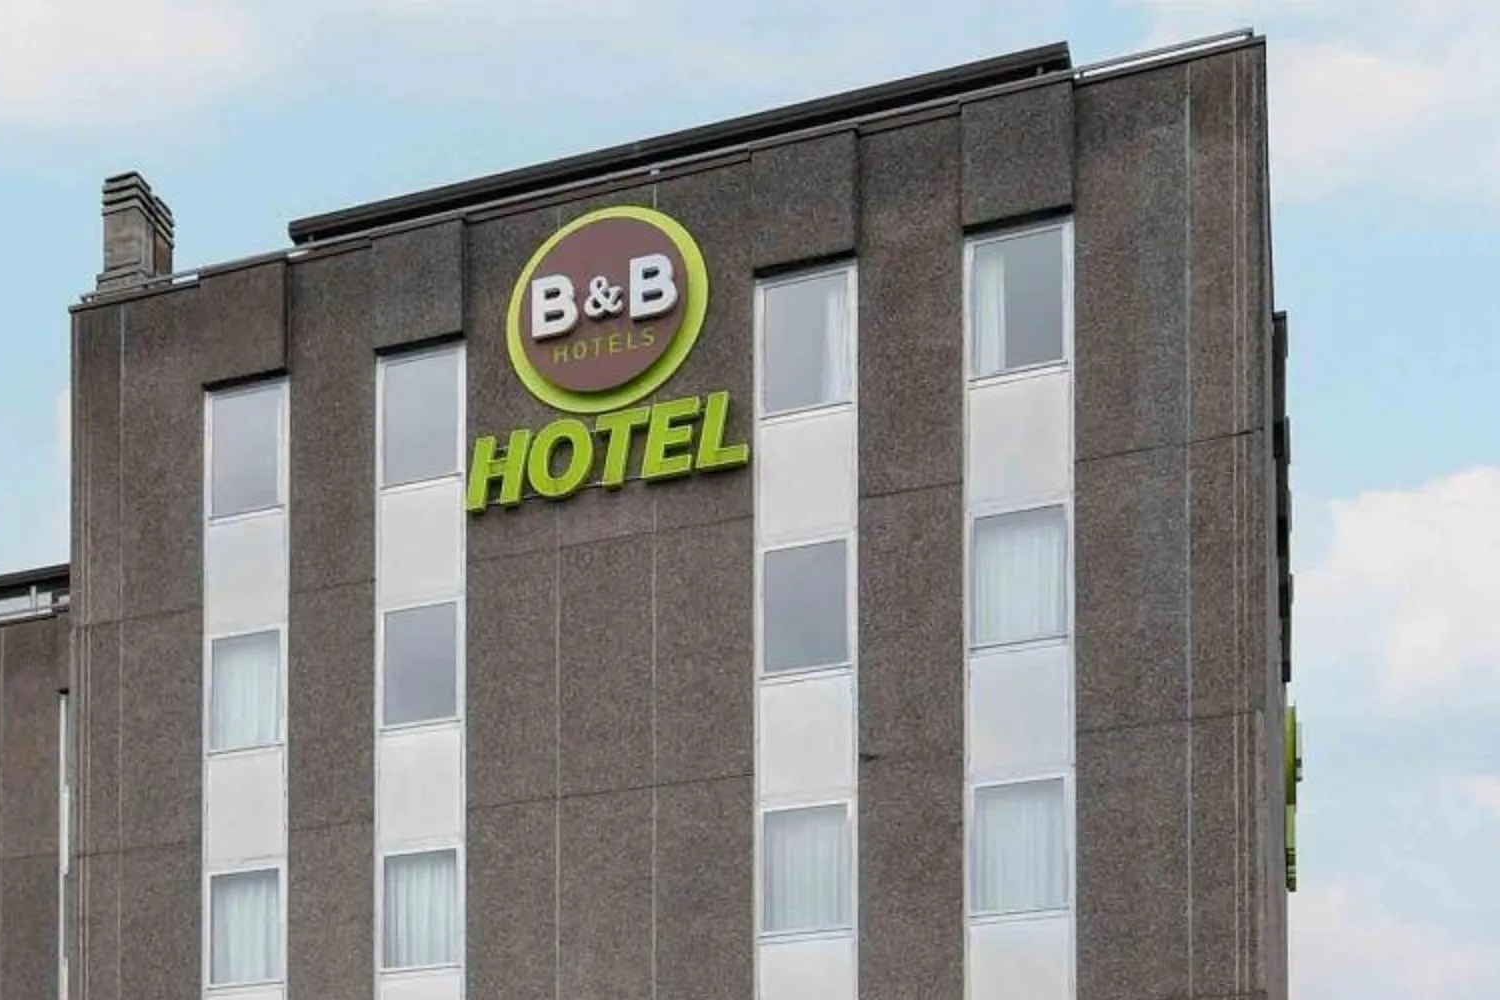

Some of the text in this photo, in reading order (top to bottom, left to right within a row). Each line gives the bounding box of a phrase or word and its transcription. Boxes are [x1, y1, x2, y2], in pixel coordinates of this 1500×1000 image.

[531, 254, 678, 340] B&B
[553, 328, 655, 363] HOTELS
[466, 391, 749, 511] HOTEL
